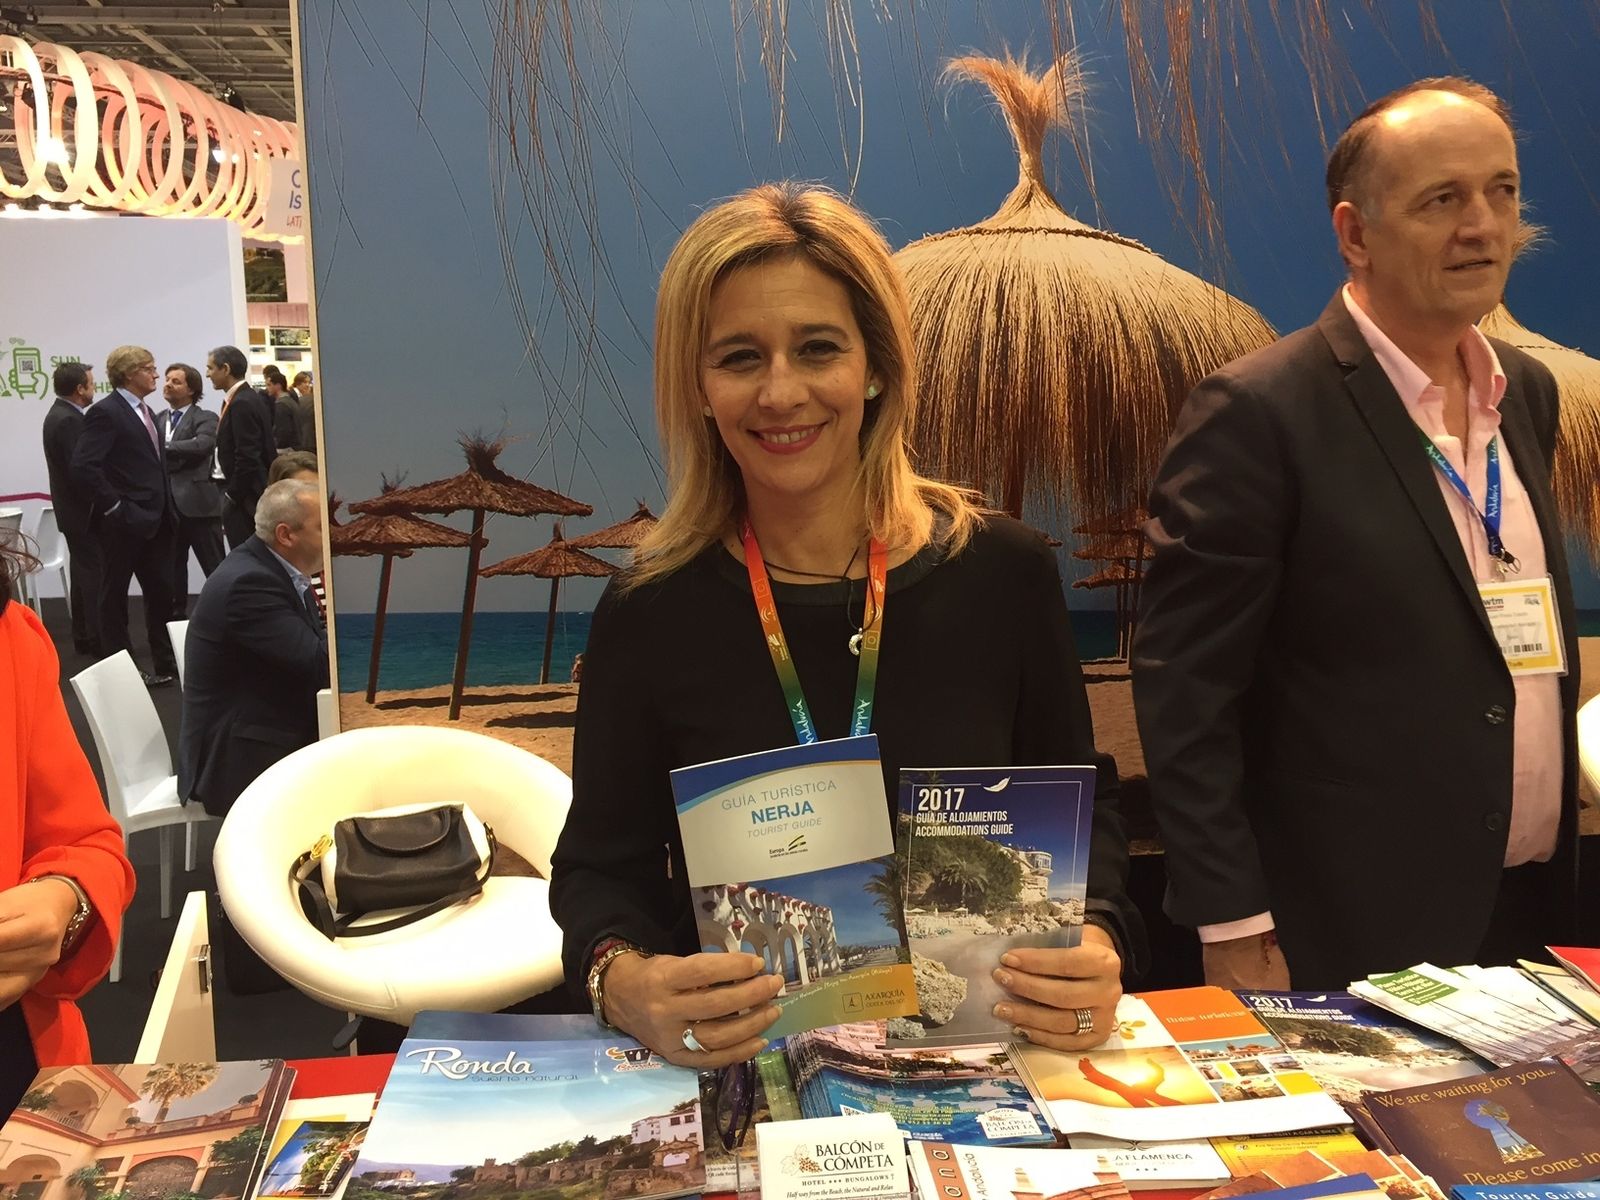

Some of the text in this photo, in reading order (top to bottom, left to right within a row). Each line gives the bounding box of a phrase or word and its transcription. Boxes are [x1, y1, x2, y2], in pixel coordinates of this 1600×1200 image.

[721, 779, 837, 810] GUÍA TURÍSTICA
[917, 787, 965, 811] 2017
[751, 800, 814, 824] NERJA
[916, 810, 1008, 824] GUÍA DE ALOJAMIENTOS
[747, 817, 823, 839] TOURIST GUIDE
[915, 823, 1014, 837] ACCOMMODATIONS GUIDE
[865, 988, 905, 1001] AXARQUÍA
[1249, 996, 1293, 1008] 2017
[1262, 1012, 1332, 1020] ACCOMMODATIONS
[405, 1046, 536, 1081] Ronda
[525, 1073, 580, 1082] natural
[1374, 1068, 1557, 1109] We are waiting for you...
[816, 1140, 886, 1157] BALCÓN DE
[823, 1154, 894, 1172] CÓMPETA
[1463, 1168, 1529, 1186] Please
[1530, 1157, 1583, 1177] come
[802, 1175, 889, 1187] HOTEL BUNGALOWS
[786, 1190, 798, 1199] Half
[808, 1190, 821, 1199] from
[852, 1185, 871, 1193] Natural
[1475, 1189, 1598, 1200] Tourist Guide
